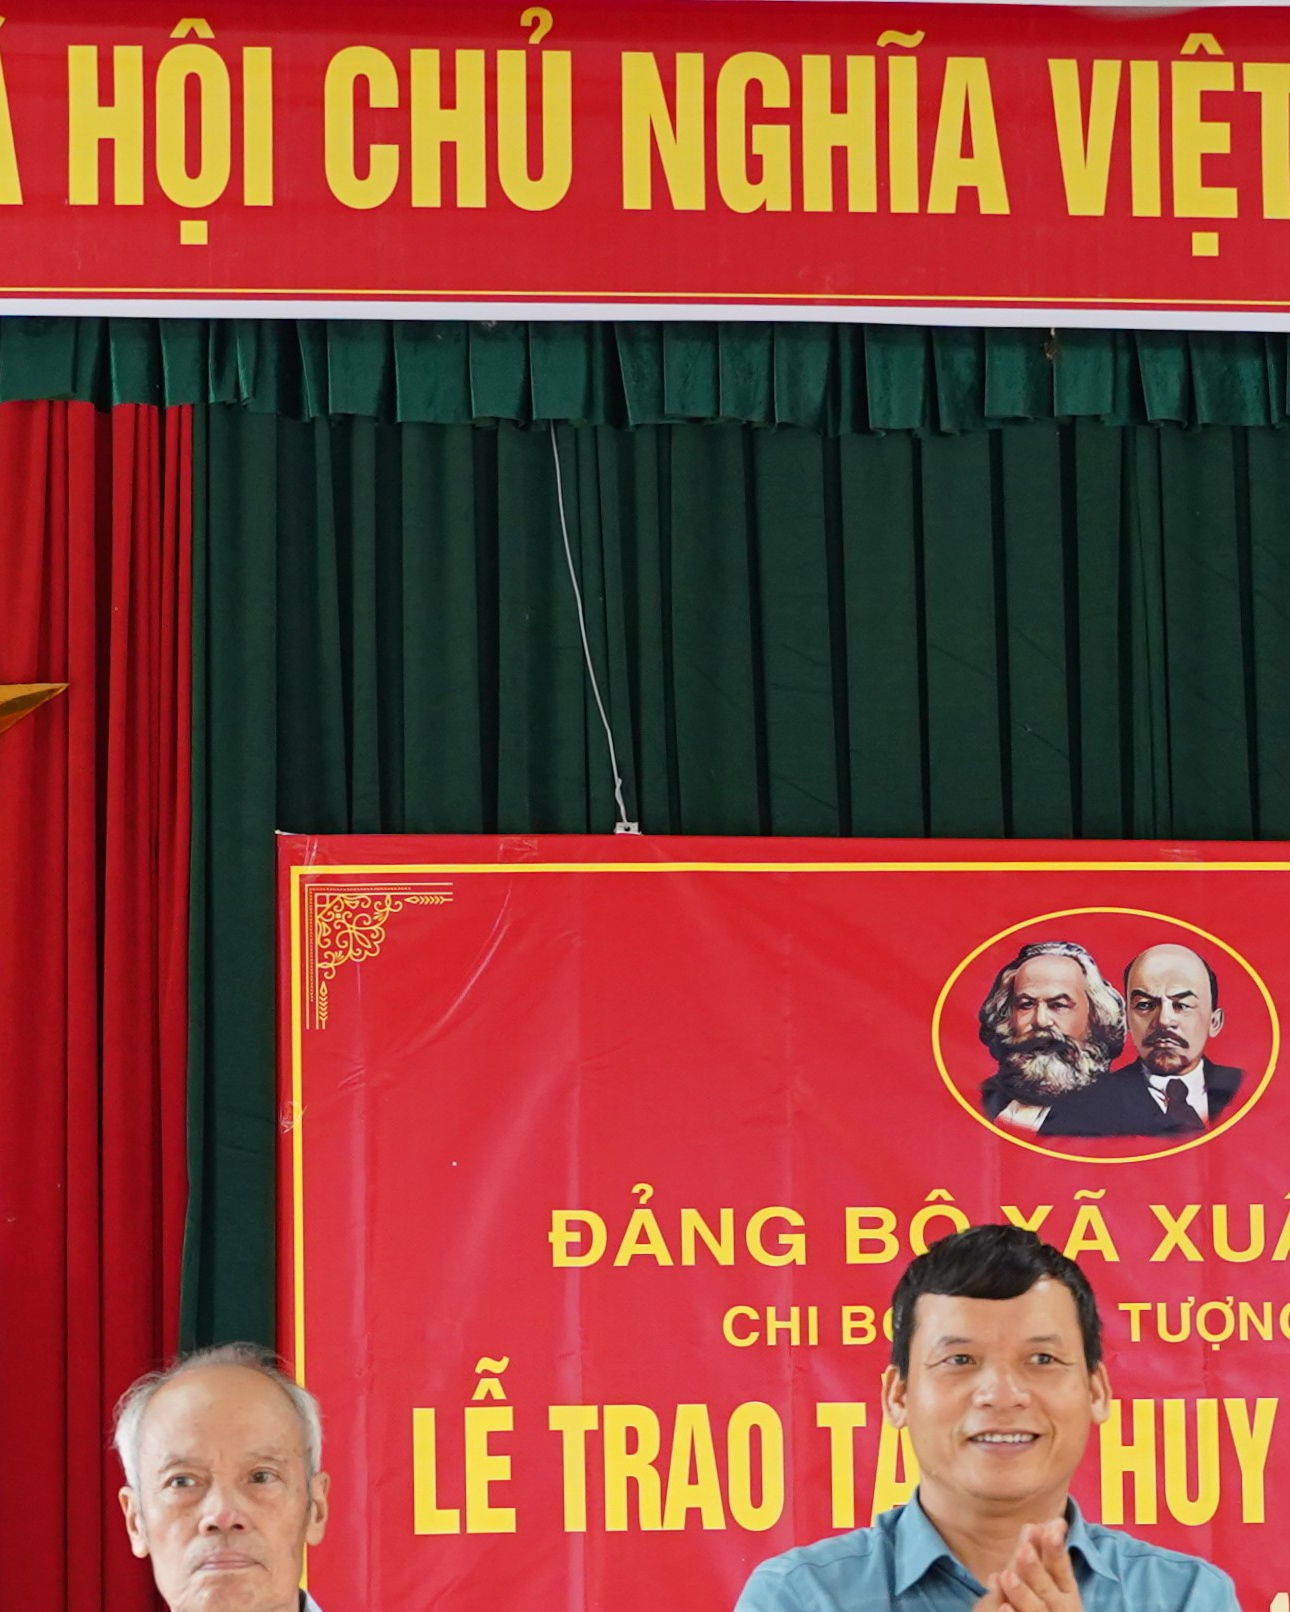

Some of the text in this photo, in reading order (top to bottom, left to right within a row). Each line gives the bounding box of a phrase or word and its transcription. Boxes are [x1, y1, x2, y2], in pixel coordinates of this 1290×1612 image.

[68, 18, 273, 245] HỘI
[324, 8, 573, 211] CHỦ
[621, 30, 1010, 214] NGHĨA
[548, 1183, 807, 1268] ĐẢNG
[722, 1305, 818, 1347] CHI
[841, 1305, 895, 1345] B
[412, 1356, 516, 1535] LỄ
[548, 1401, 786, 1533] TRAO
[1098, 1397, 1279, 1526] HUY
